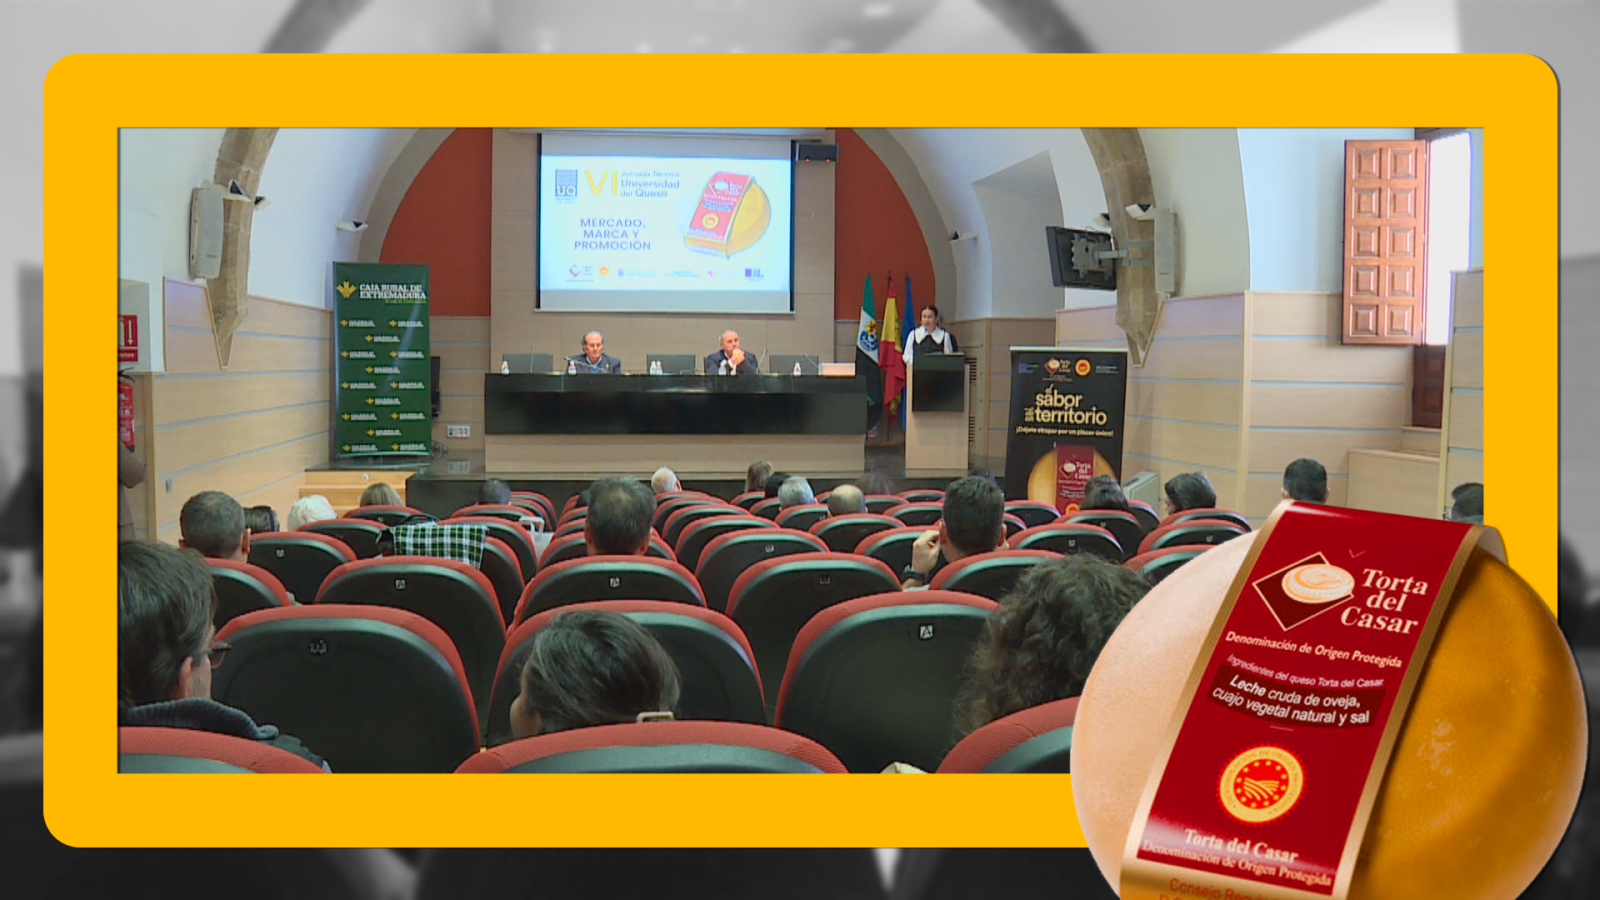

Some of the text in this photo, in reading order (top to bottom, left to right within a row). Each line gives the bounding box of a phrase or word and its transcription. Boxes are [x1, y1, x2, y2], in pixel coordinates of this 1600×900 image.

[585, 170, 617, 195] VI
[621, 179, 680, 189] Universidad
[621, 188, 668, 198] del Queso
[580, 218, 646, 228] MERCADO,
[583, 229, 639, 239] MARCA Y
[574, 240, 651, 250] PROMOCIÓN
[360, 291, 427, 299] EXTREMADURA
[381, 284, 408, 292] RURAL
[1035, 389, 1083, 408] sabor
[1034, 406, 1108, 425] territorio
[1361, 568, 1428, 596] Torta
[1365, 589, 1407, 612] del
[1340, 605, 1419, 634] Casar
[1225, 631, 1403, 668] Denominación de Origen Protegida
[1226, 653, 1385, 688] Ingredientes del queso Torta del Casar
[1229, 674, 1361, 709] Leche cruda de oveja,
[1212, 686, 1370, 726] cuajo vegetal natural y sal
[1184, 827, 1299, 863] Torta del Casar
[1142, 839, 1332, 886] Denominación de Origen Protegida
[1169, 877, 1221, 899] Consejo
